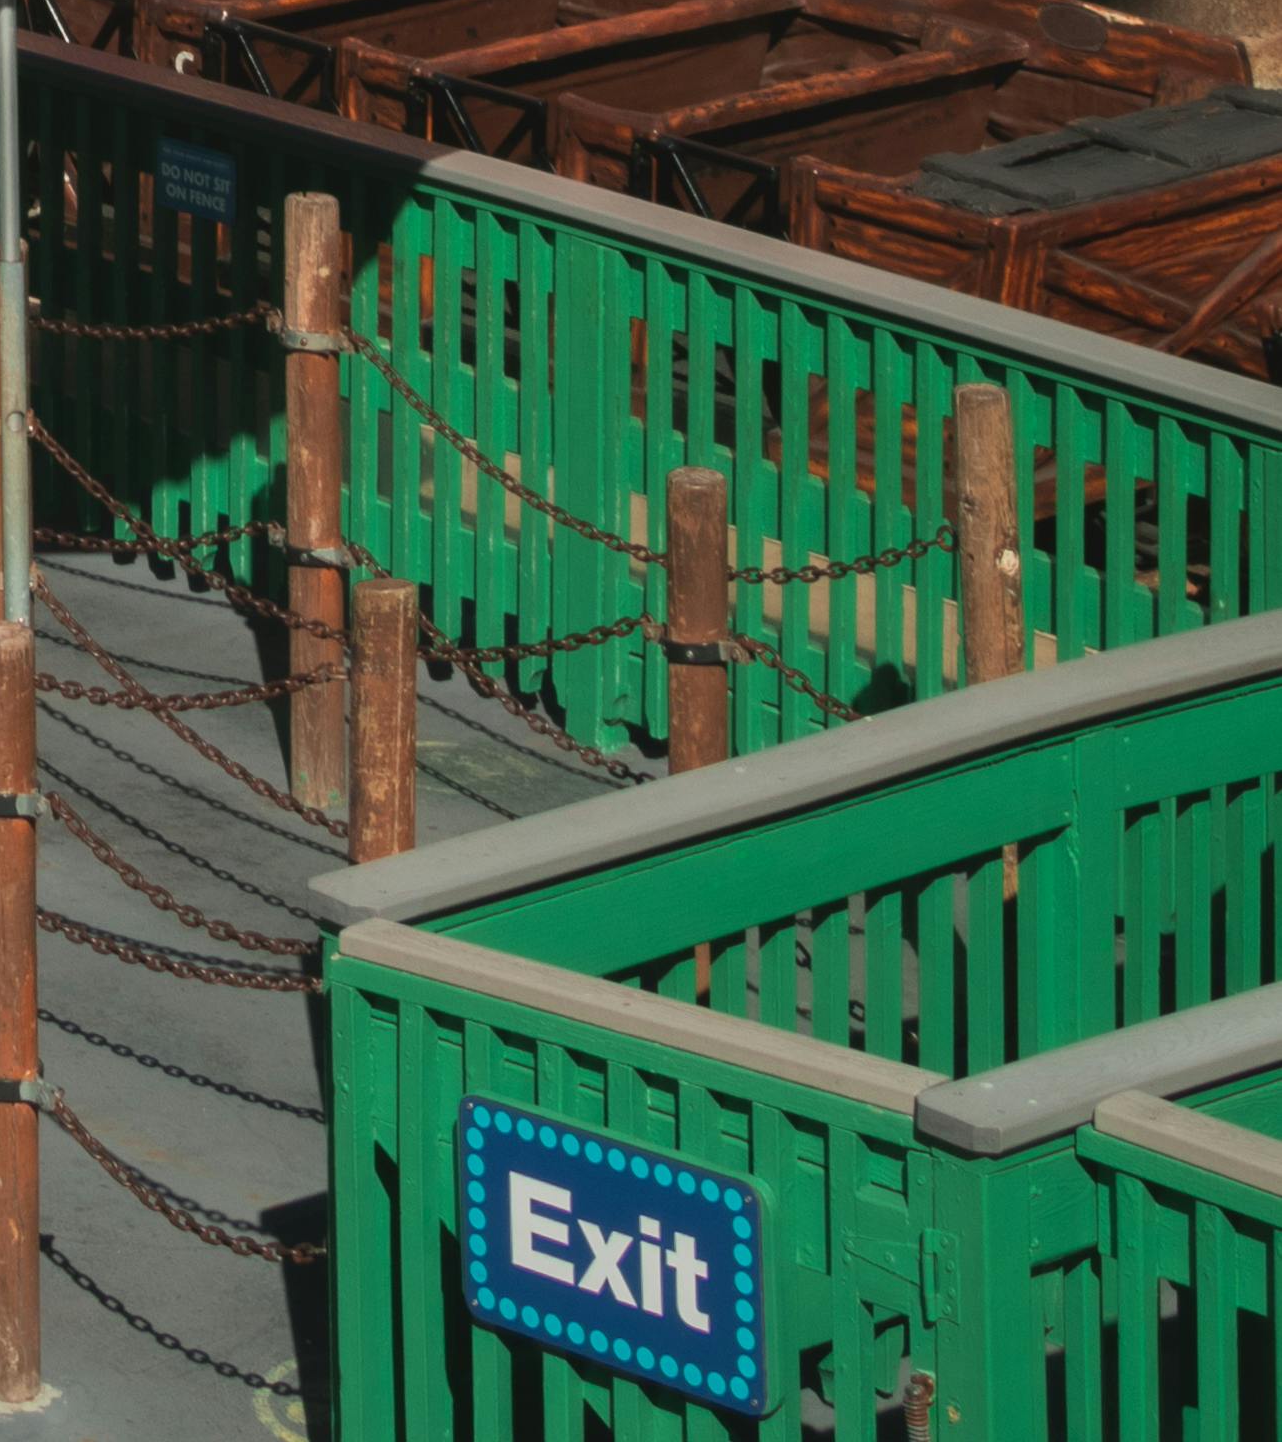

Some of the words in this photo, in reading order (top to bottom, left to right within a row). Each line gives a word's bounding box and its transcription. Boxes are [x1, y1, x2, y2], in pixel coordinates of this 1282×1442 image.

[160, 161, 181, 180] DO
[183, 167, 211, 188] NOT
[213, 176, 231, 194] SIT
[165, 182, 187, 201] ON
[189, 189, 226, 213] FENCE
[509, 1170, 711, 1334] Exit
